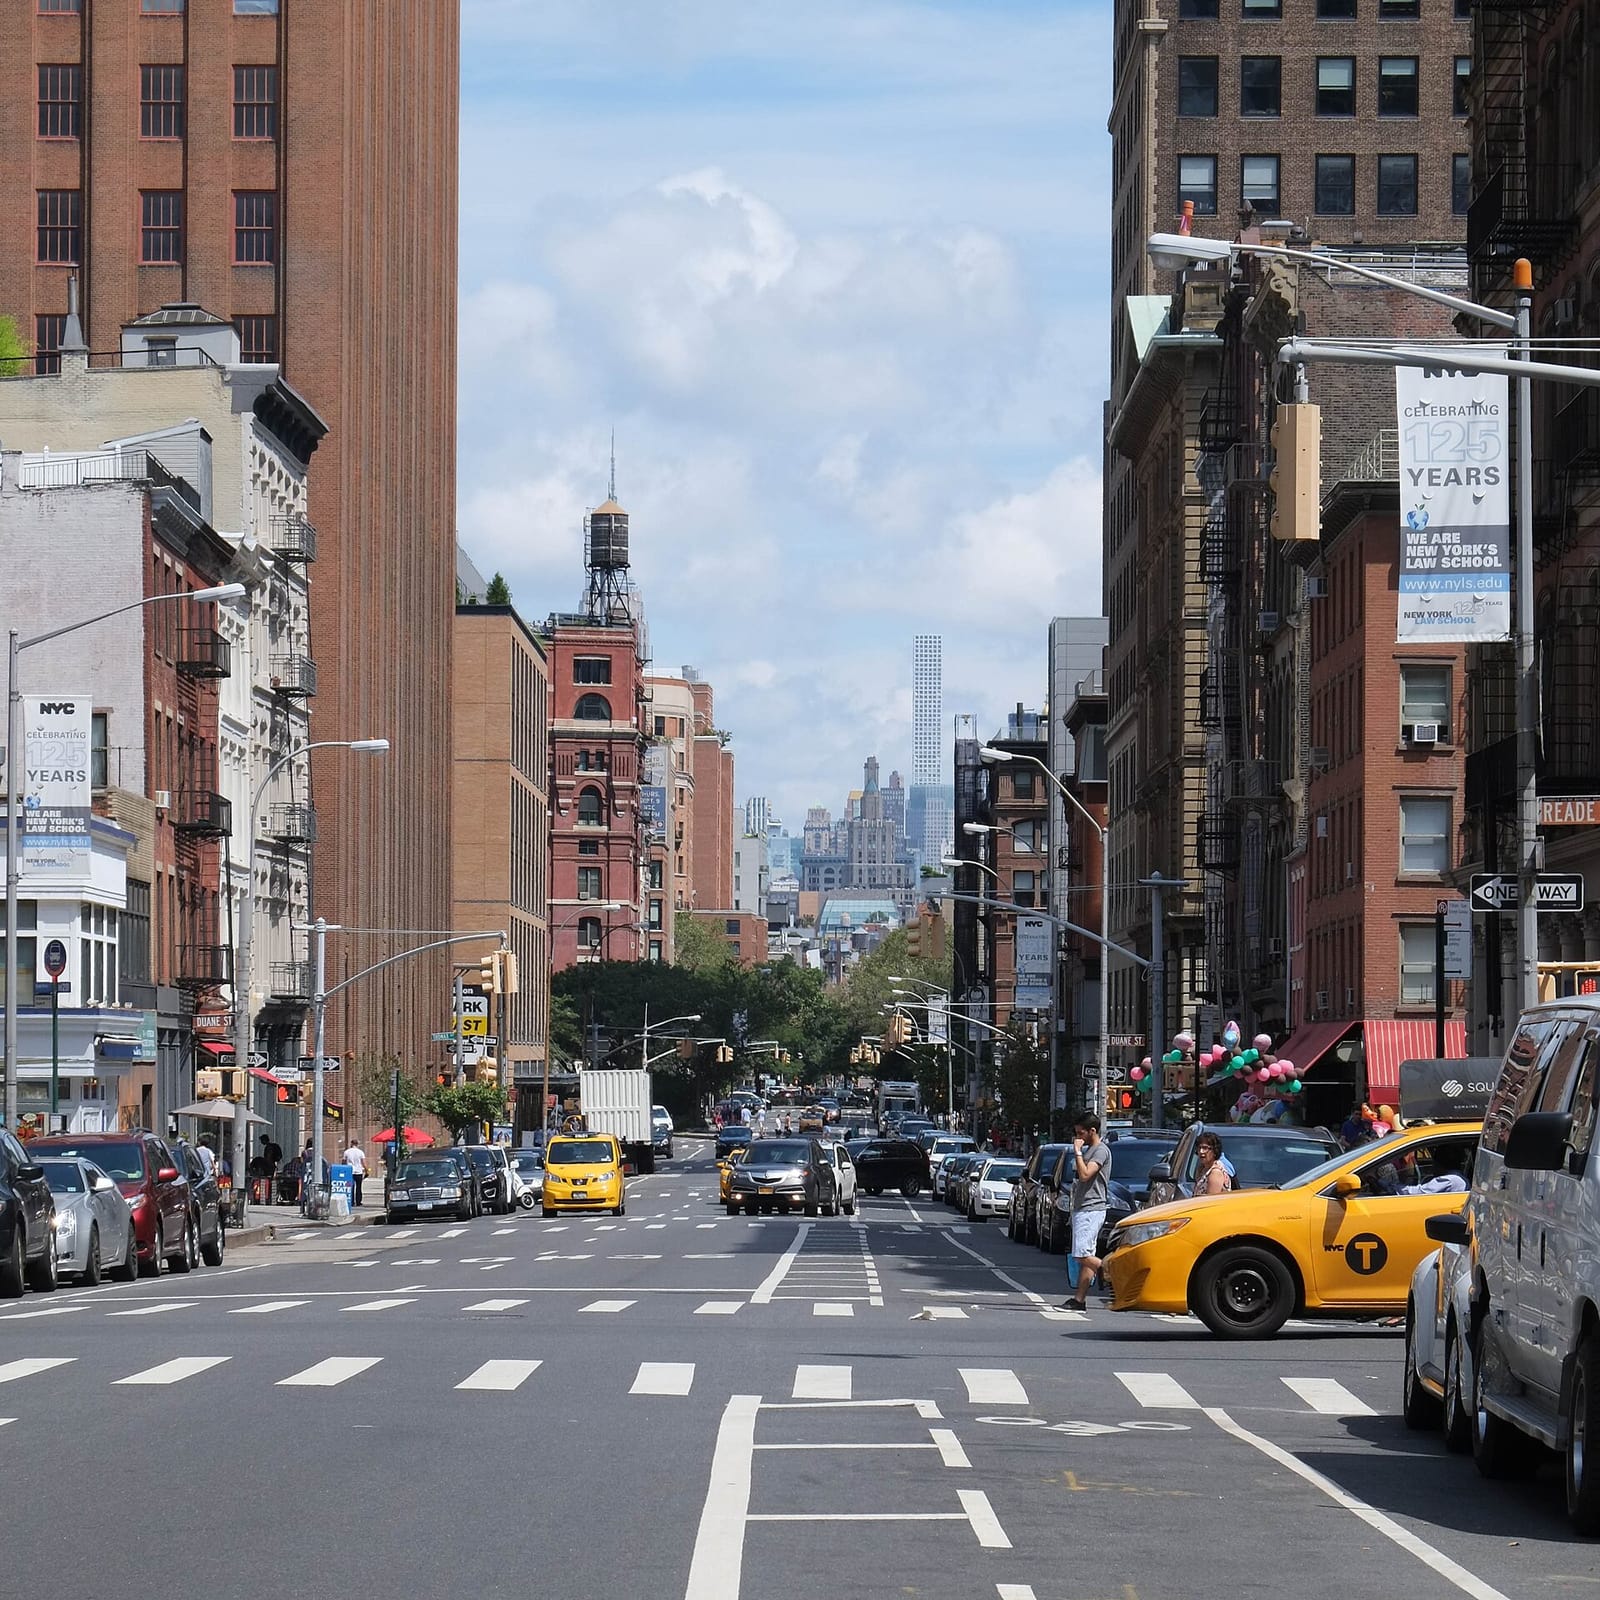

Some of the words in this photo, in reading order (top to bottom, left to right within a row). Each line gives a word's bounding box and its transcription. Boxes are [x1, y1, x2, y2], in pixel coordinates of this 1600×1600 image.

[1404, 404, 1499, 417] CELEBRATING
[1404, 420, 1501, 463] 125
[1406, 466, 1500, 487] YEARS
[1406, 533, 1427, 544] WE
[1431, 532, 1461, 544] ARE
[1406, 545, 1438, 556] NEW
[1442, 544, 1498, 556] YORK'S
[1405, 558, 1437, 569] LAW
[1441, 556, 1502, 568] SCHOOL
[1405, 577, 1503, 592] www.nyls.edu
[1454, 601, 1486, 615] 125
[1403, 611, 1426, 619] NEW
[1427, 610, 1452, 618] YORK
[1414, 617, 1436, 625] LAW
[1437, 616, 1476, 625] SCHOOL
[40, 703, 75, 714] NYC
[26, 731, 86, 739] CELEBRATING
[26, 741, 87, 768] 125
[26, 770, 86, 782] YEARS
[1543, 801, 1595, 822] READE
[1483, 886, 1518, 899] ONE
[1538, 886, 1572, 899] WAY
[453, 1002, 483, 1012] RK
[196, 1016, 220, 1027] DUANE
[223, 1016, 232, 1027] ST
[453, 1020, 482, 1031] ST
[1111, 1036, 1132, 1046] DUANE
[1354, 1242, 1378, 1270] T
